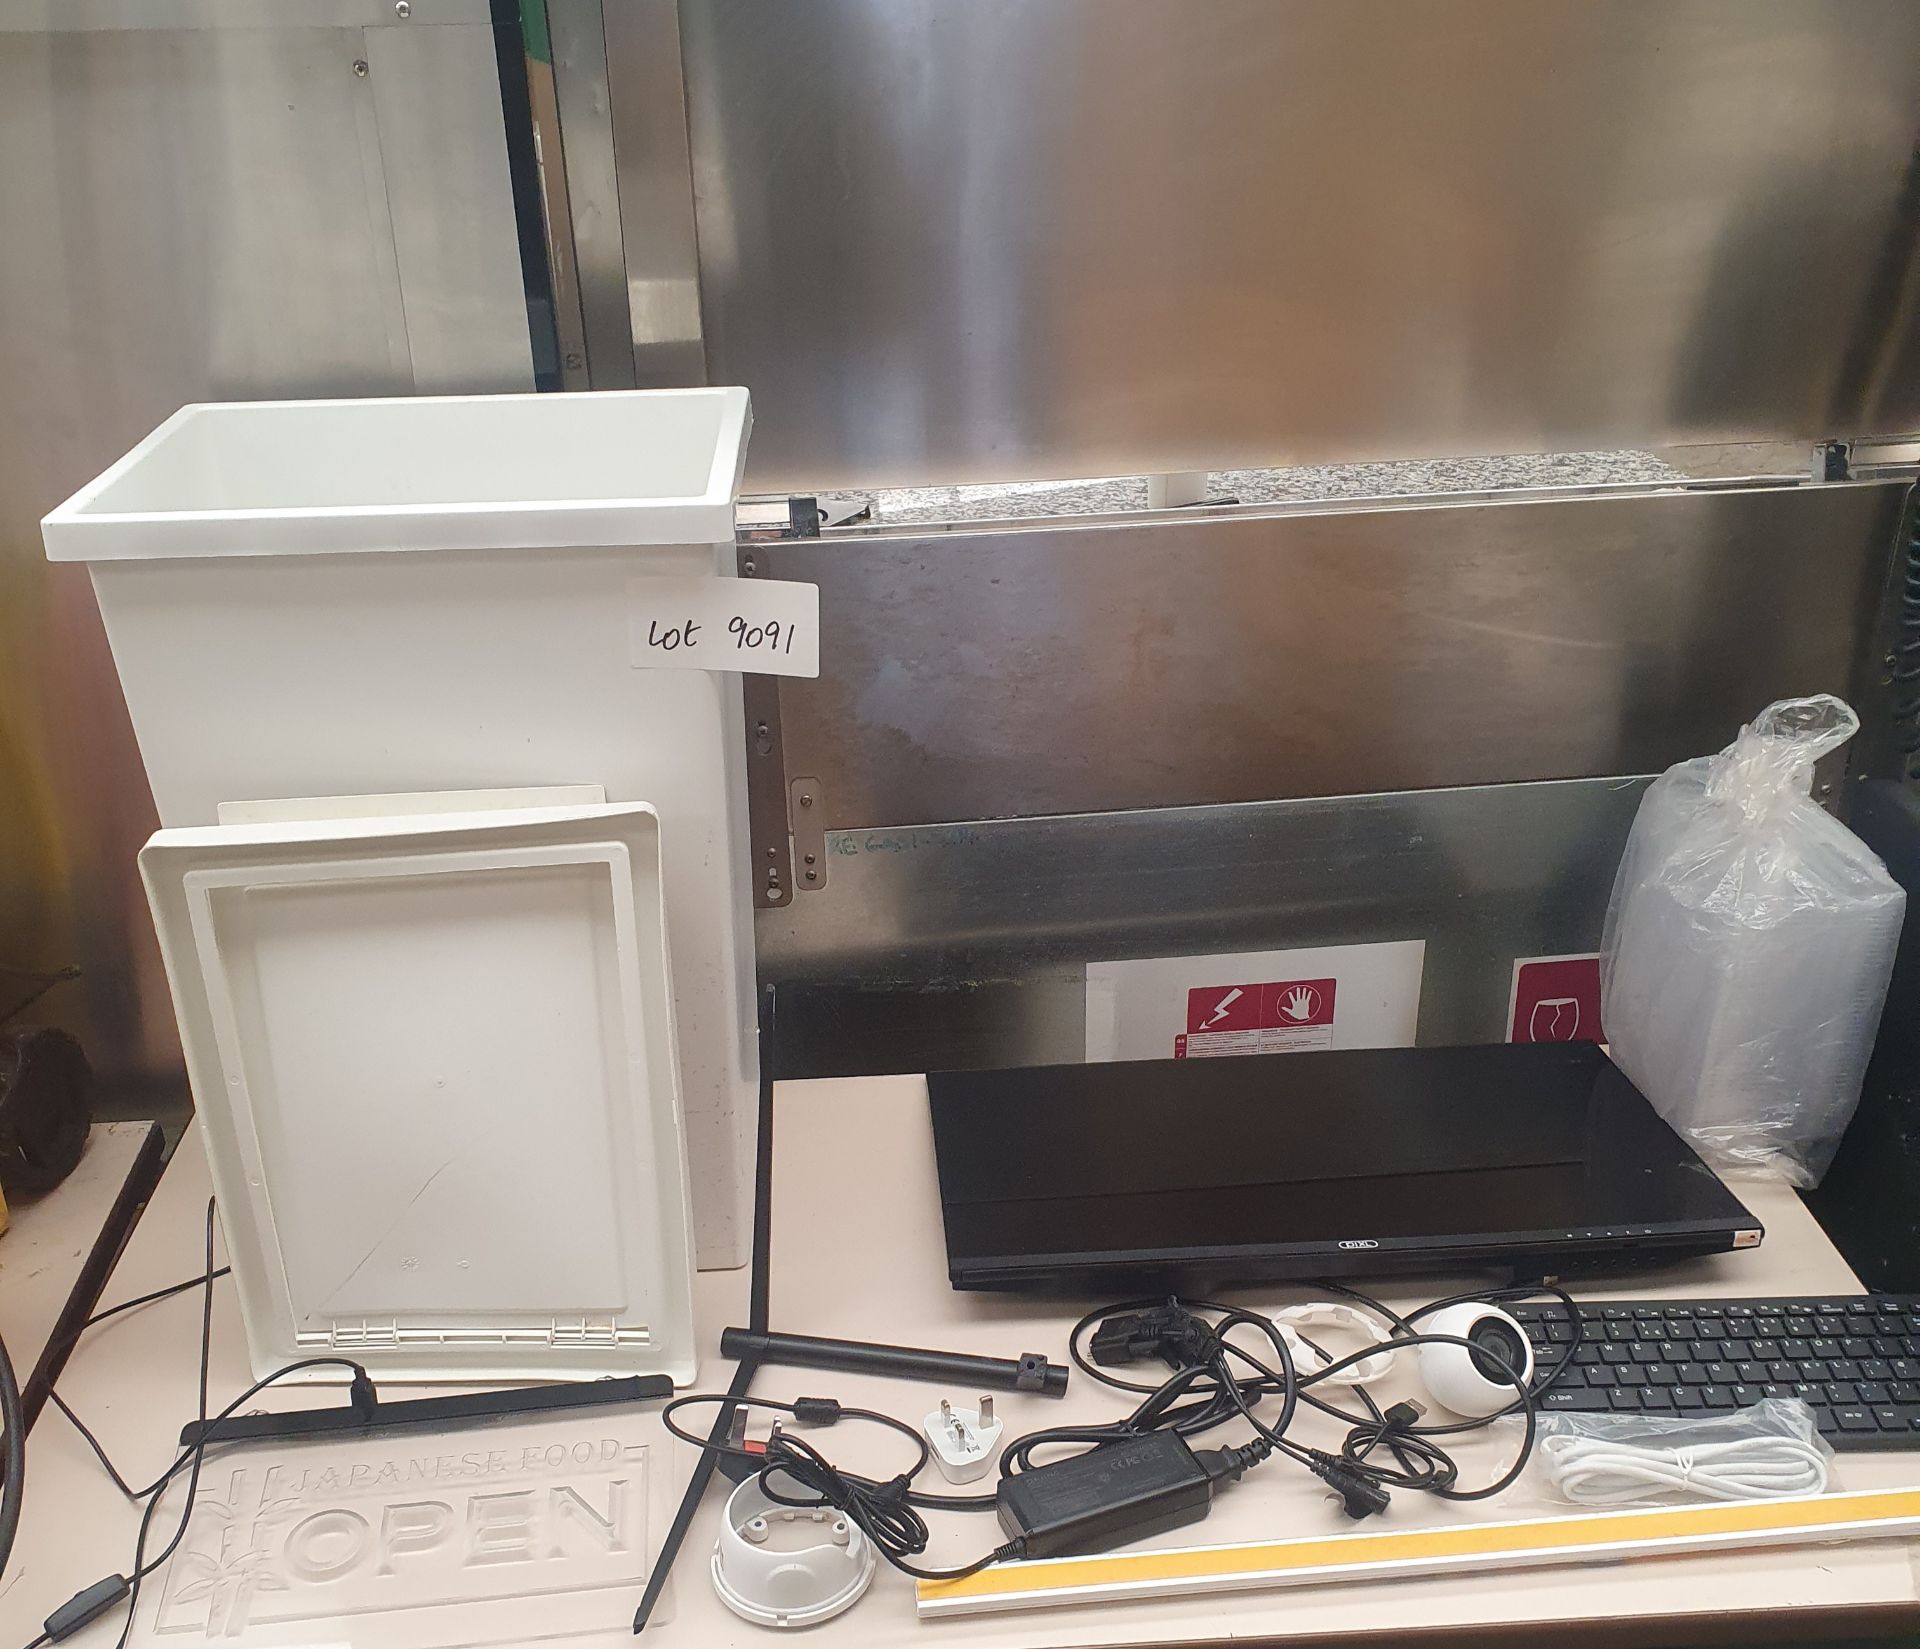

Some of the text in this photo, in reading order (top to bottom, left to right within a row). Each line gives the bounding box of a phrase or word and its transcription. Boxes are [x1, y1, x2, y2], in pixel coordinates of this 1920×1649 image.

[648, 616, 796, 655] Lot 9091
[289, 1439, 621, 1490] JAPANESE FOOD
[284, 1479, 630, 1584] OPEN
